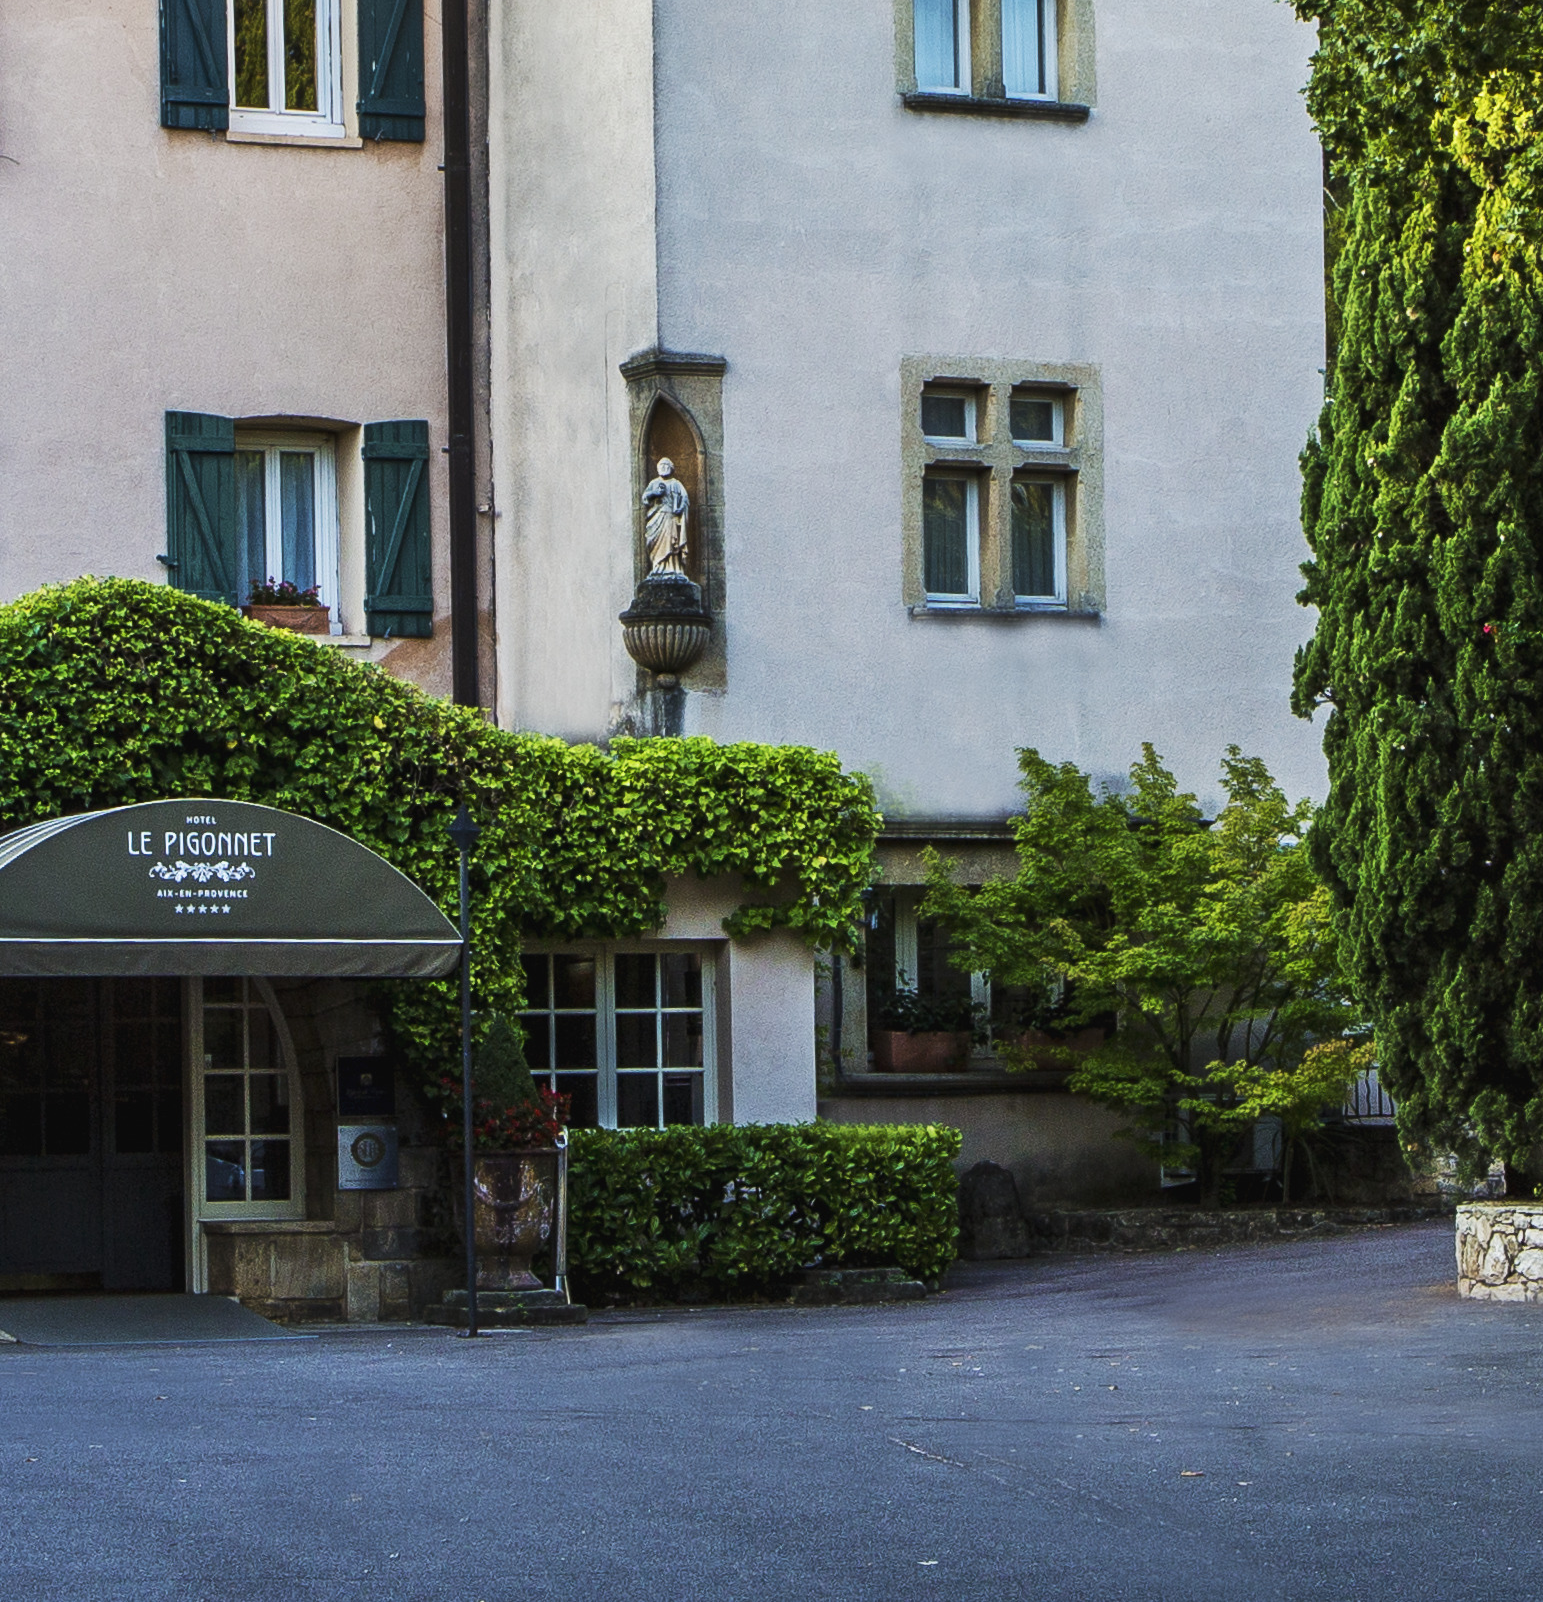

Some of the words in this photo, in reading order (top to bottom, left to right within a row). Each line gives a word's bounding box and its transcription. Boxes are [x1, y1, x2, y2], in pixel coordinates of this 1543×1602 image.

[186, 815, 217, 825] HOTEL
[127, 831, 153, 856] LE
[164, 831, 276, 857] PIGONNET
[156, 889, 249, 898] AIX-EN-PROVENCE
